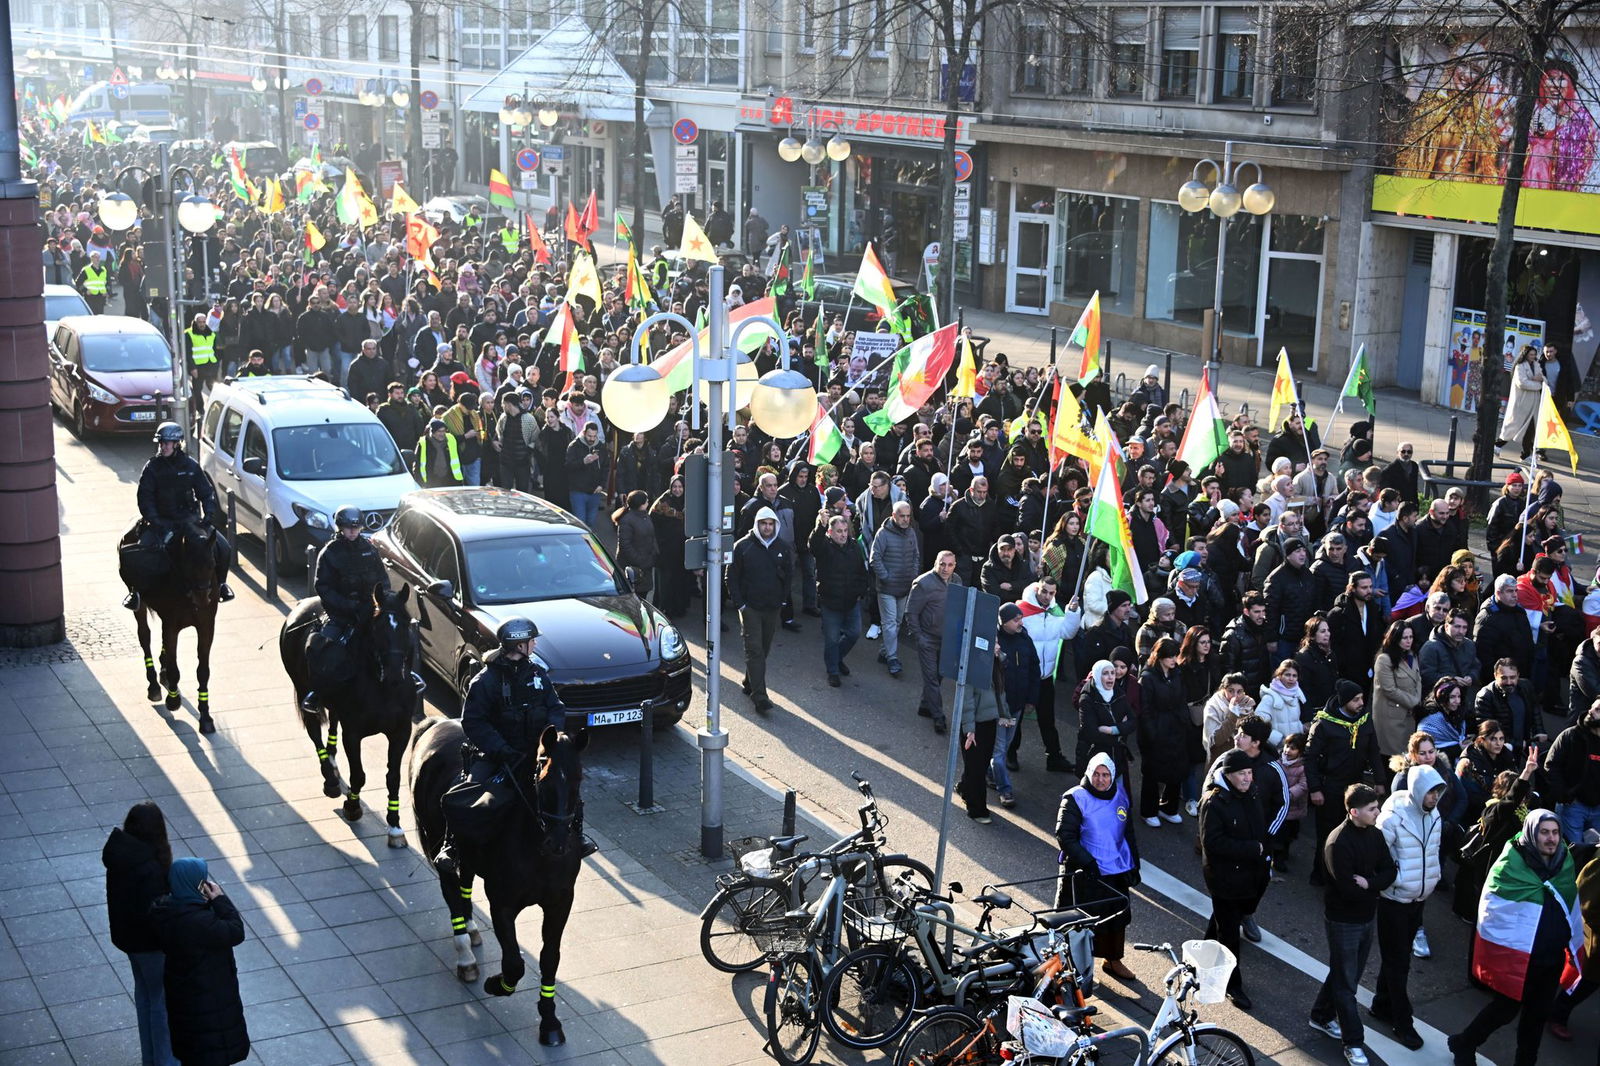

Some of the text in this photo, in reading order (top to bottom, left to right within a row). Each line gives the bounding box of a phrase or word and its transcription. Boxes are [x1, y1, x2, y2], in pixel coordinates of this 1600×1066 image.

[594, 710, 643, 724] MA TP 123
